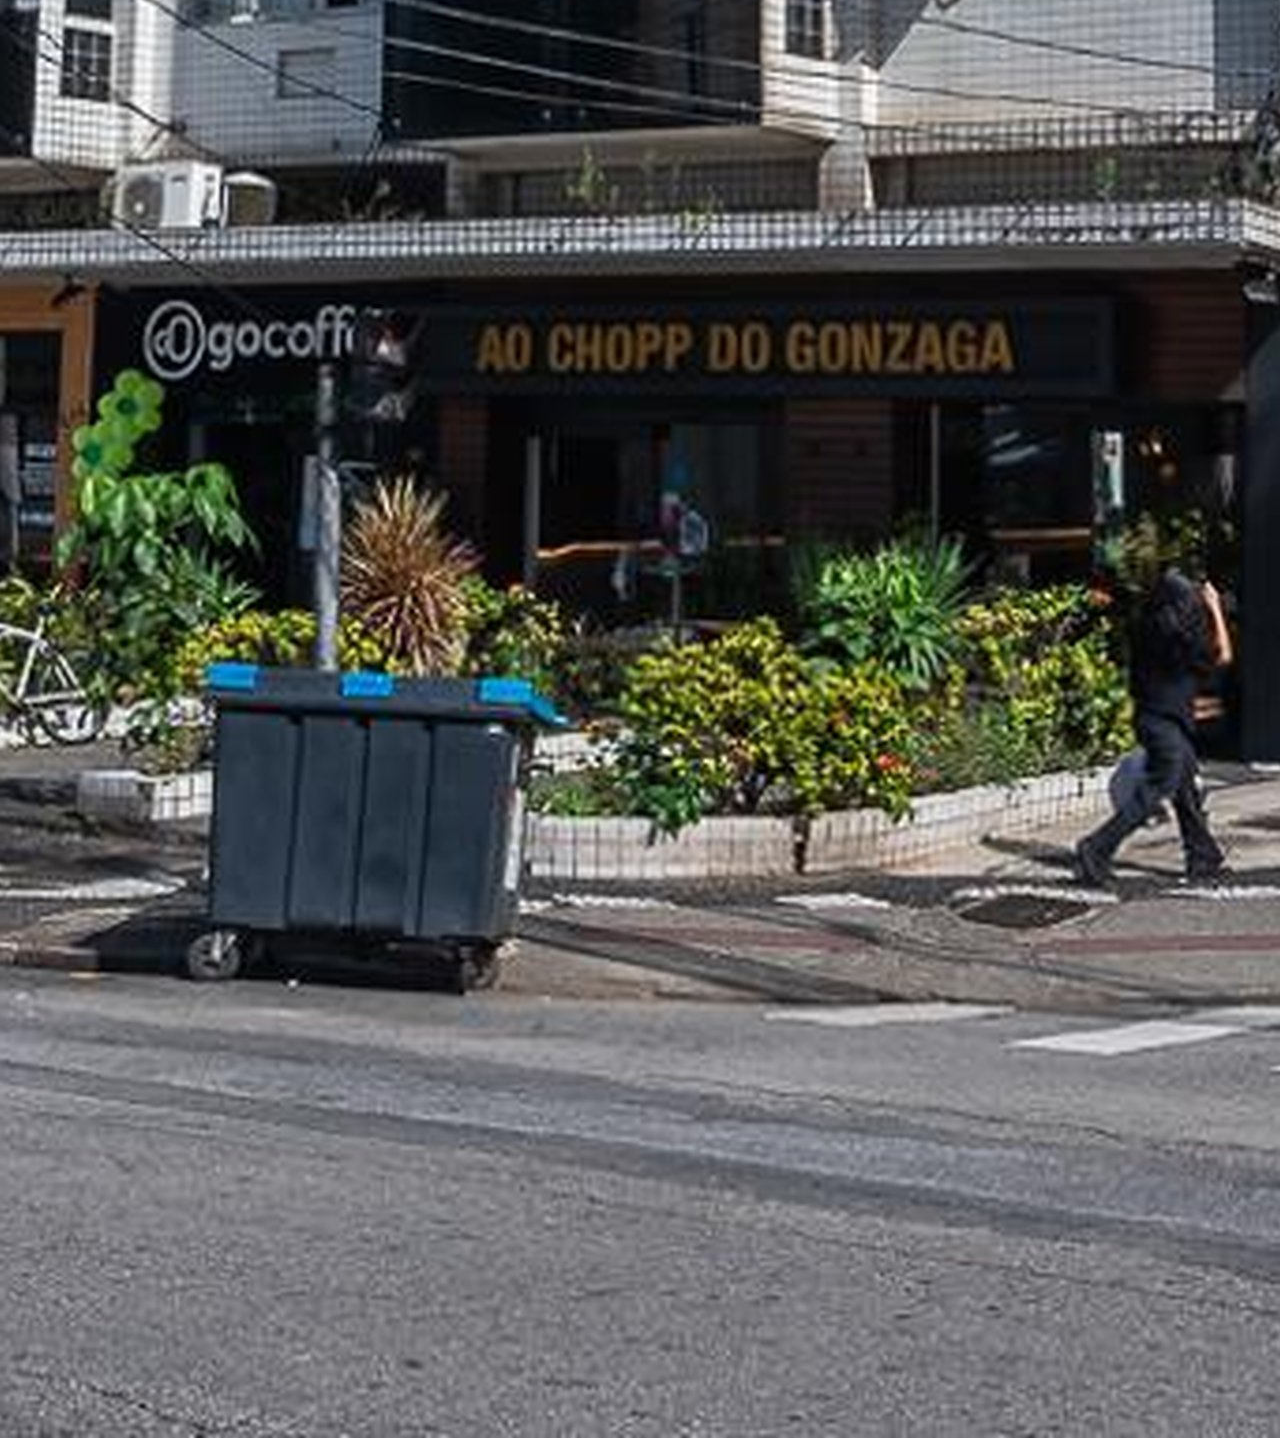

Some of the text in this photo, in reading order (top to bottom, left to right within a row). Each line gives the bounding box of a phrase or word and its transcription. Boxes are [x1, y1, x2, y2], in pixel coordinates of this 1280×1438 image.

[208, 304, 356, 370] gocoff
[477, 320, 1014, 372] AO CHOPP DO GONZAGA
